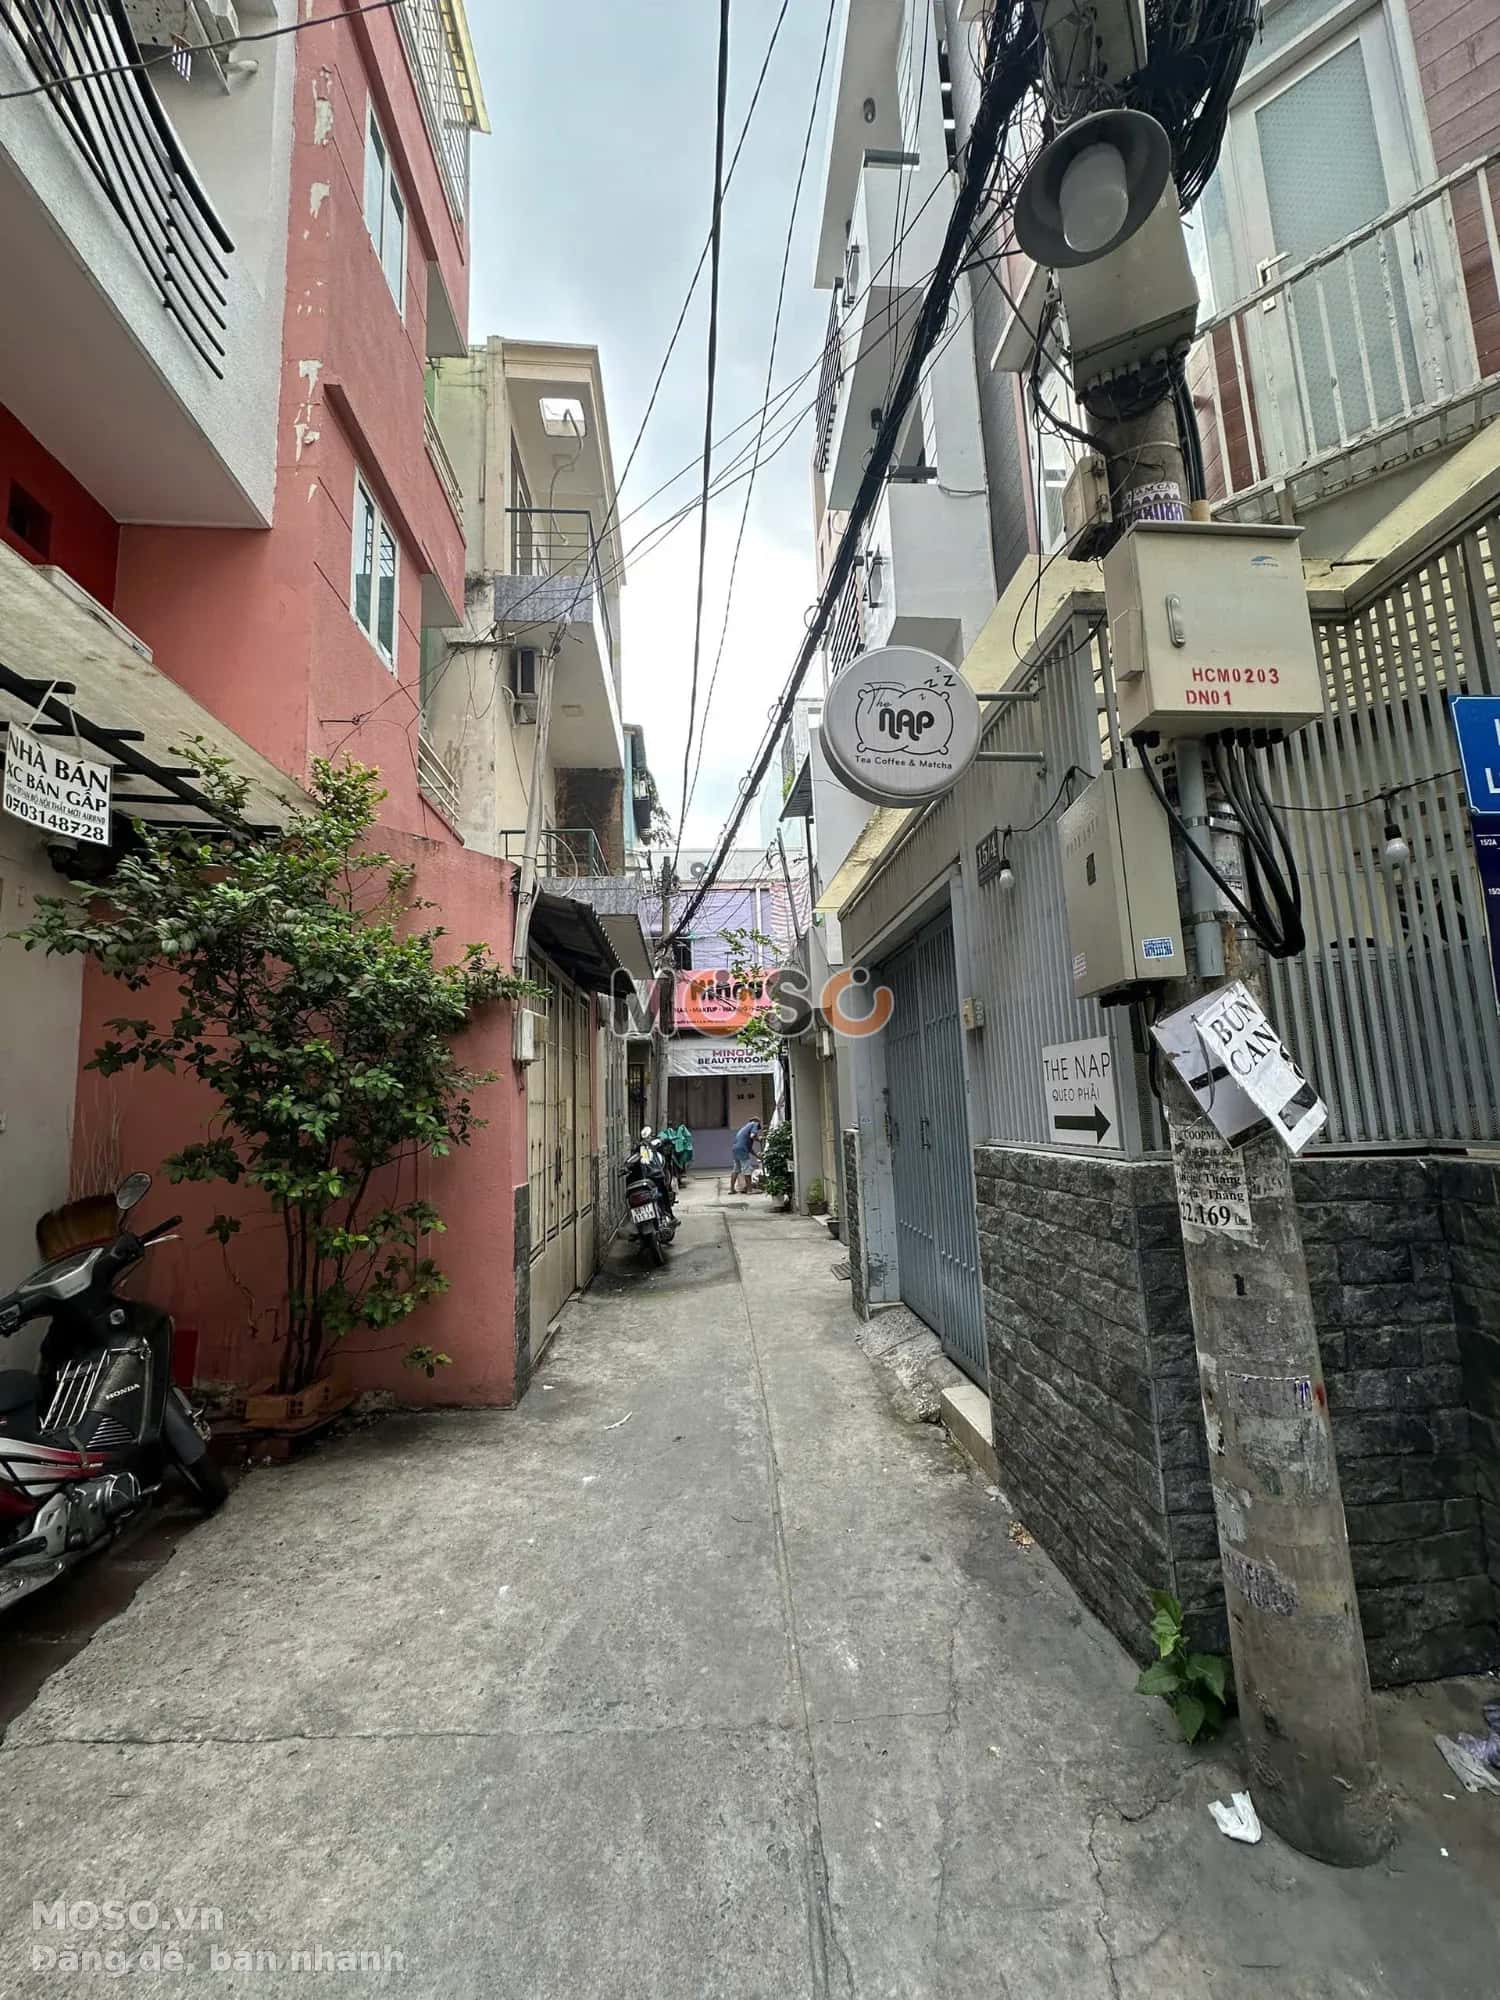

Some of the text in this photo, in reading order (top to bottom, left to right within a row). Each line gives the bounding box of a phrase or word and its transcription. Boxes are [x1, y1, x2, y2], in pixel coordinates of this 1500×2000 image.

[1192, 667, 1280, 684] HCM0203
[1185, 690, 1232, 705] DN01
[8, 730, 47, 774] NHÀ
[55, 759, 108, 793] BÁN
[856, 754, 953, 770] Tea Coffee & Matcha
[26, 773, 60, 800] BÁN
[65, 789, 107, 812] GẤP
[5, 793, 105, 841] 0703148728
[1210, 993, 1258, 1047] BÚN
[1043, 1051, 1111, 1082] THE NAP
[105, 1383, 140, 1401] HONDA
